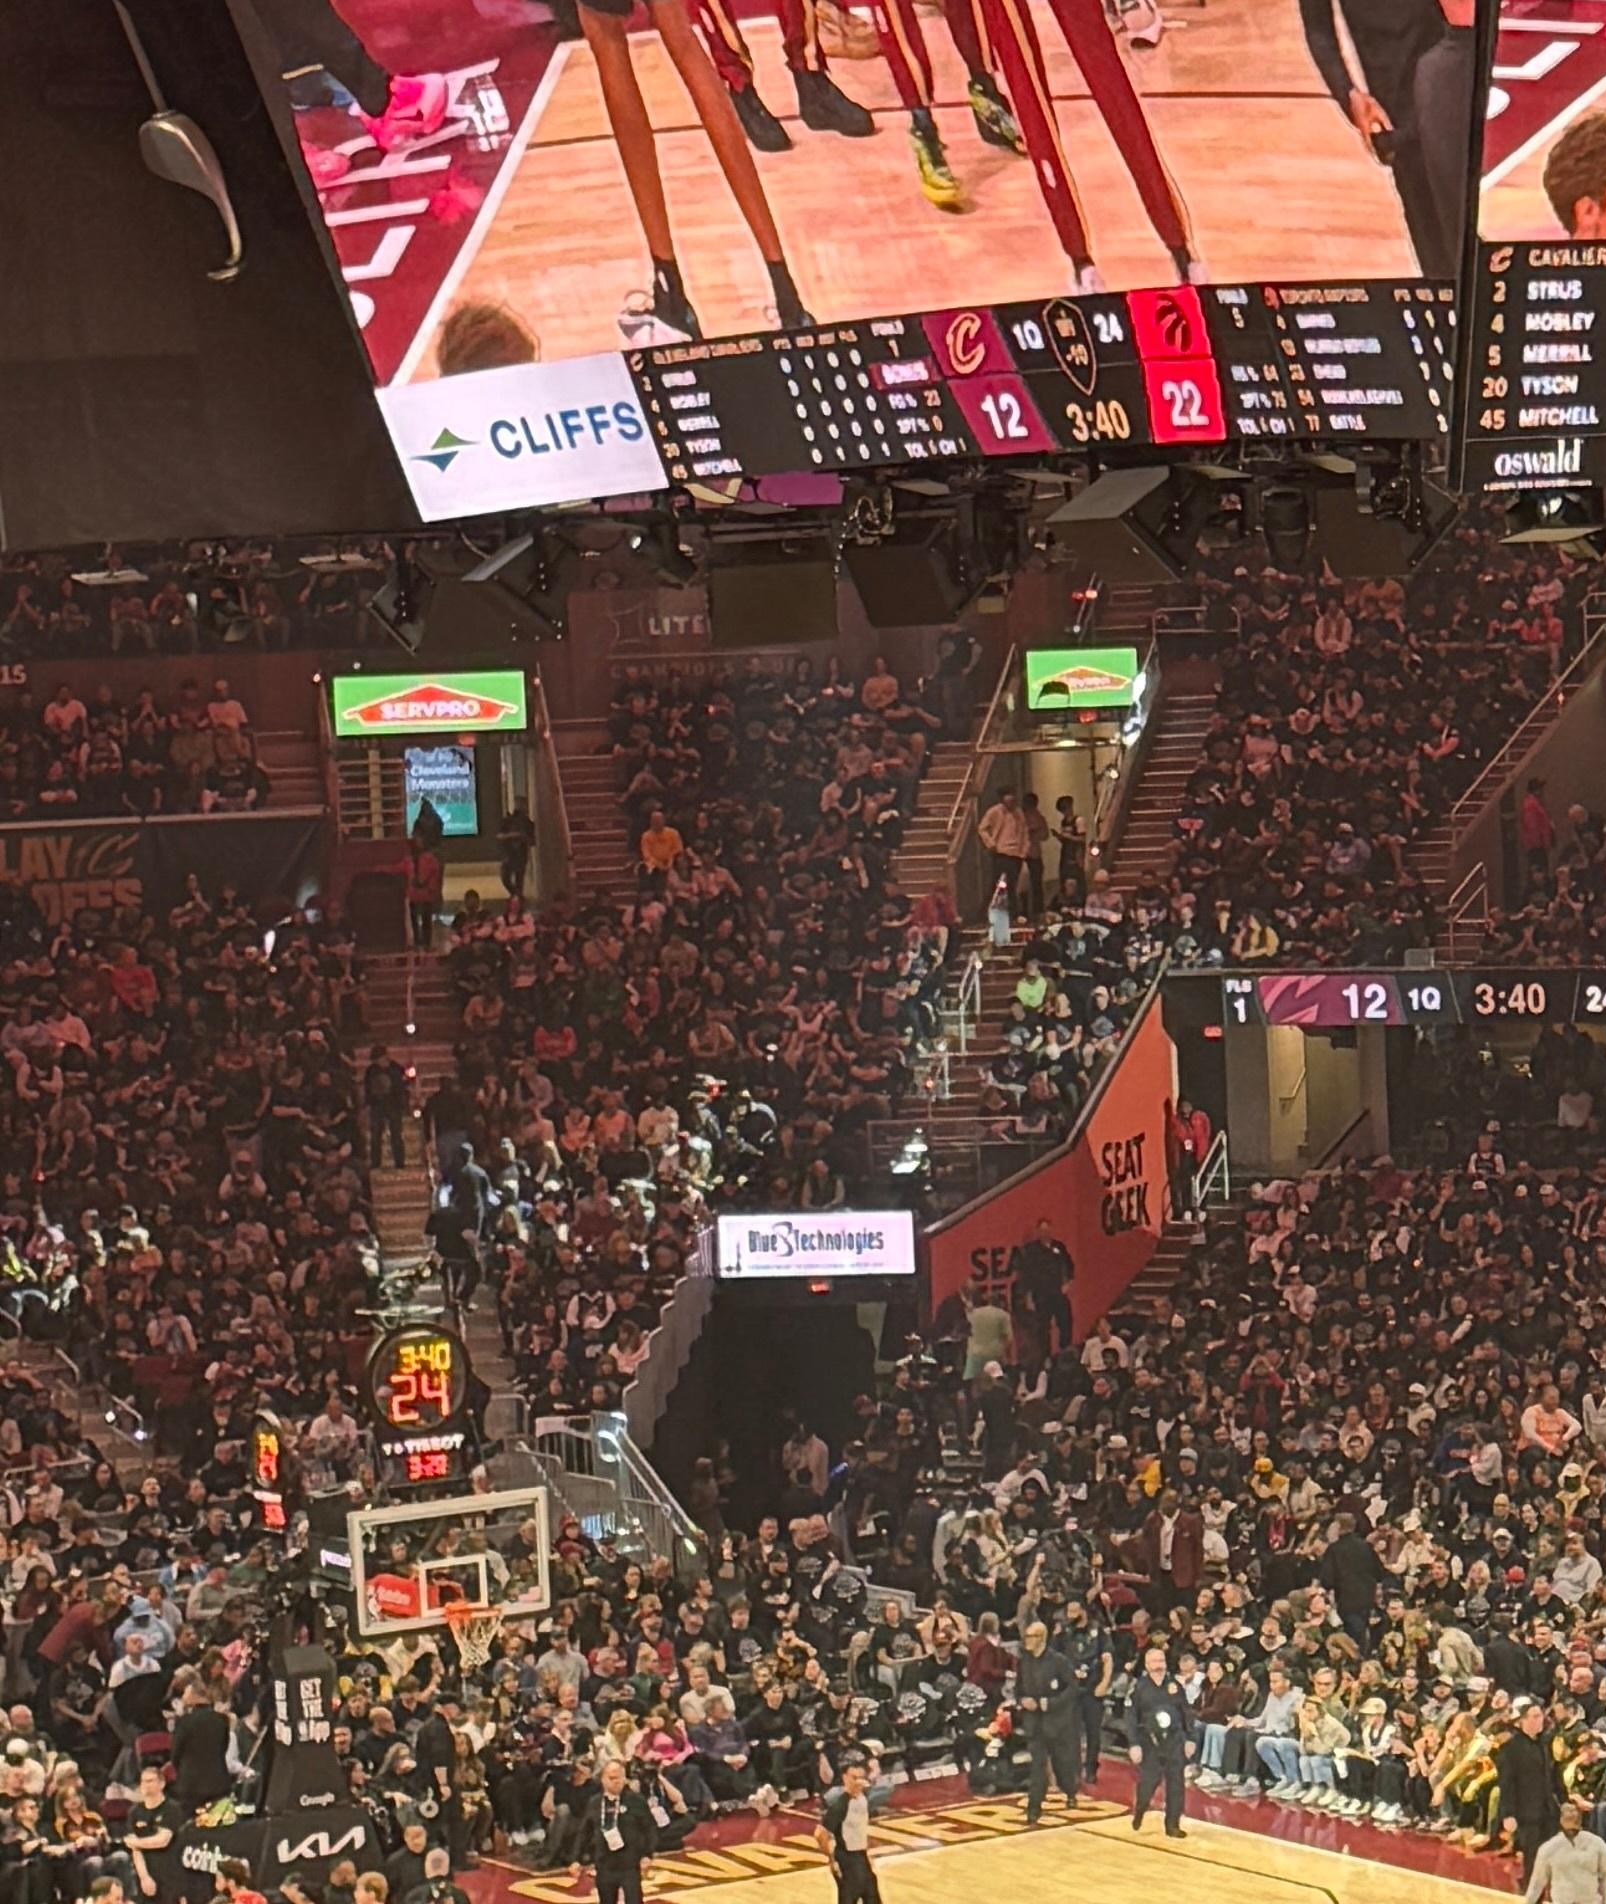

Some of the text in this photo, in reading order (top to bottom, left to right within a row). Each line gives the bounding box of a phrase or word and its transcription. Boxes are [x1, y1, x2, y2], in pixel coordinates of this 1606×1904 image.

[1161, 379, 1211, 427] 22
[1482, 376, 1509, 399] 20
[490, 400, 646, 461] CLIFFS
[980, 392, 1029, 441] 12
[1066, 399, 1131, 443] 3:40
[1479, 405, 1600, 431] 45 MITCHELL
[1494, 437, 1584, 477] oswald
[380, 699, 482, 721] SERVPRO
[0, 836, 71, 881] LAY
[1225, 978, 1253, 994] FLS
[1341, 982, 1389, 1020] 12
[1408, 985, 1442, 1013] 1Q
[1474, 982, 1547, 1017] 3:40
[1233, 997, 1246, 1024] 1
[1102, 1132, 1146, 1189] SEAT
[747, 1226, 885, 1254] Blue Technologies
[398, 1341, 452, 1374] 3:40
[389, 1372, 451, 1424] 24
[277, 1826, 367, 1863] KIA
